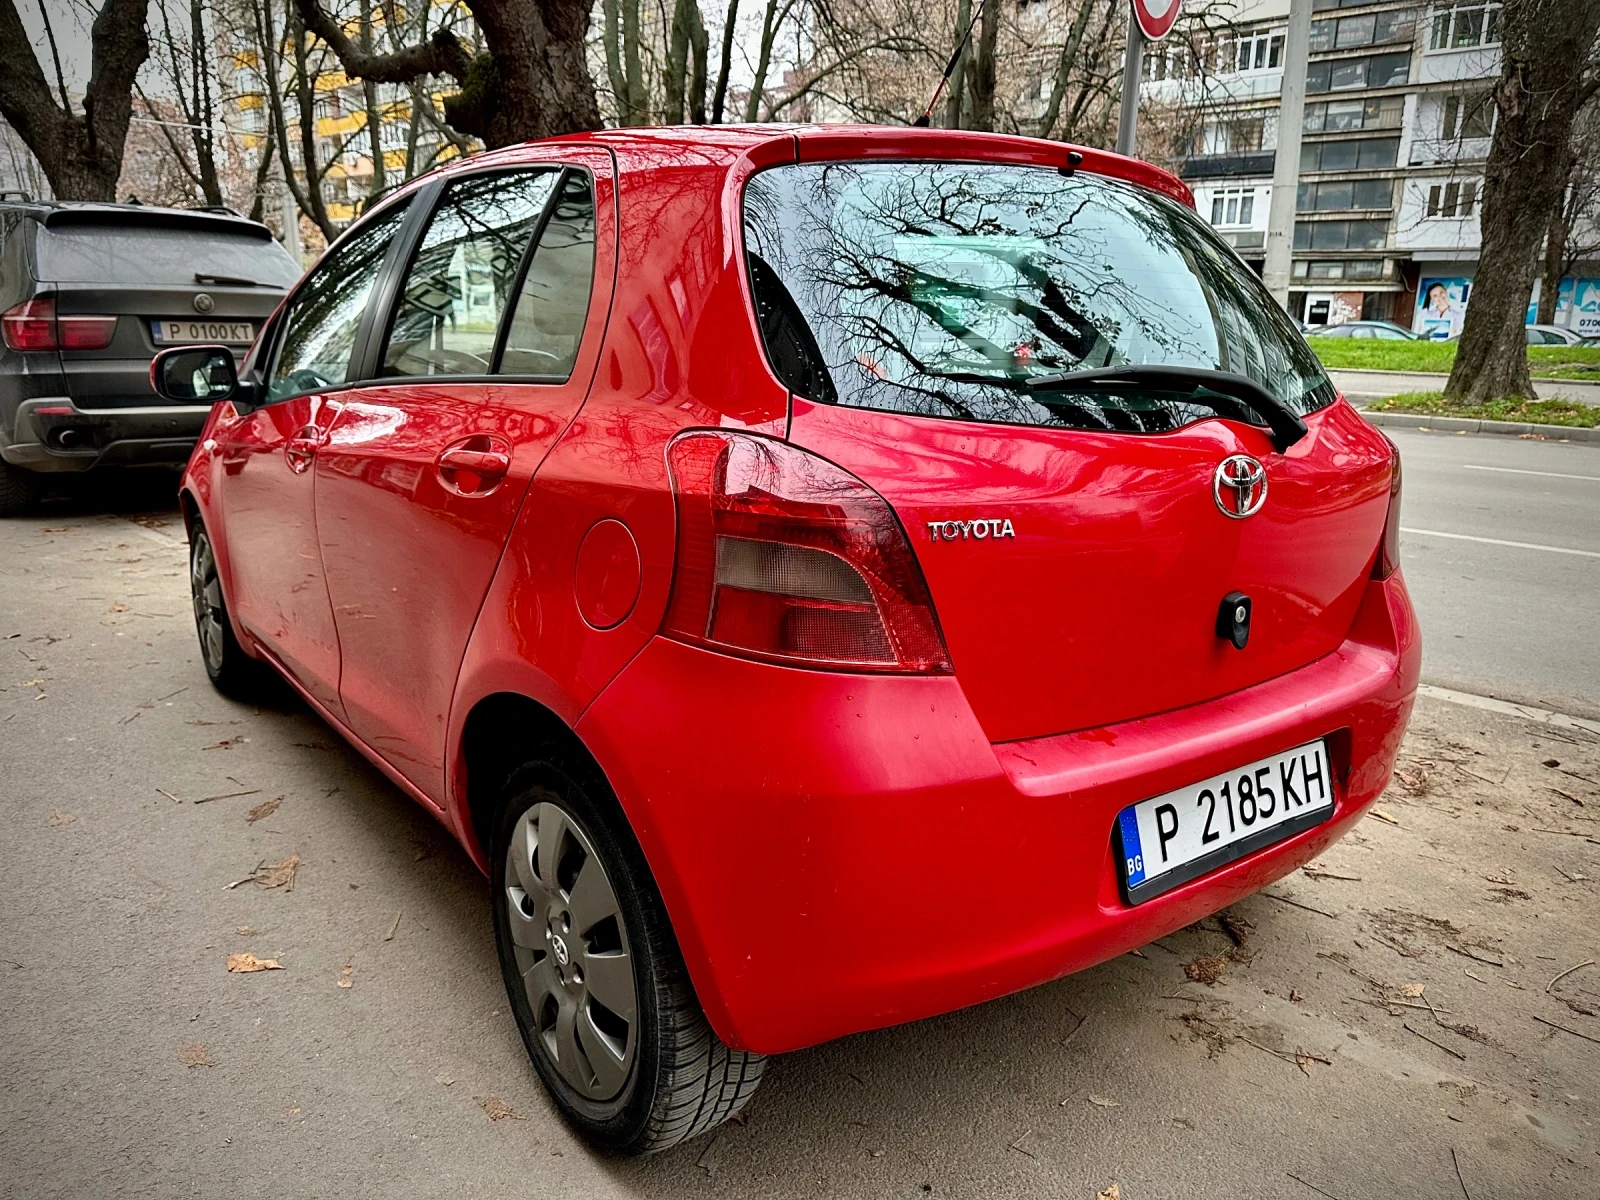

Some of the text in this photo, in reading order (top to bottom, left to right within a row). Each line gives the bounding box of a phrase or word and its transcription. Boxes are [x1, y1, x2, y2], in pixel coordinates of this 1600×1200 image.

[169, 323, 180, 339] P
[926, 519, 1015, 541] TOYOTA
[1154, 802, 1179, 863] P
[1127, 854, 1143, 876] BG
